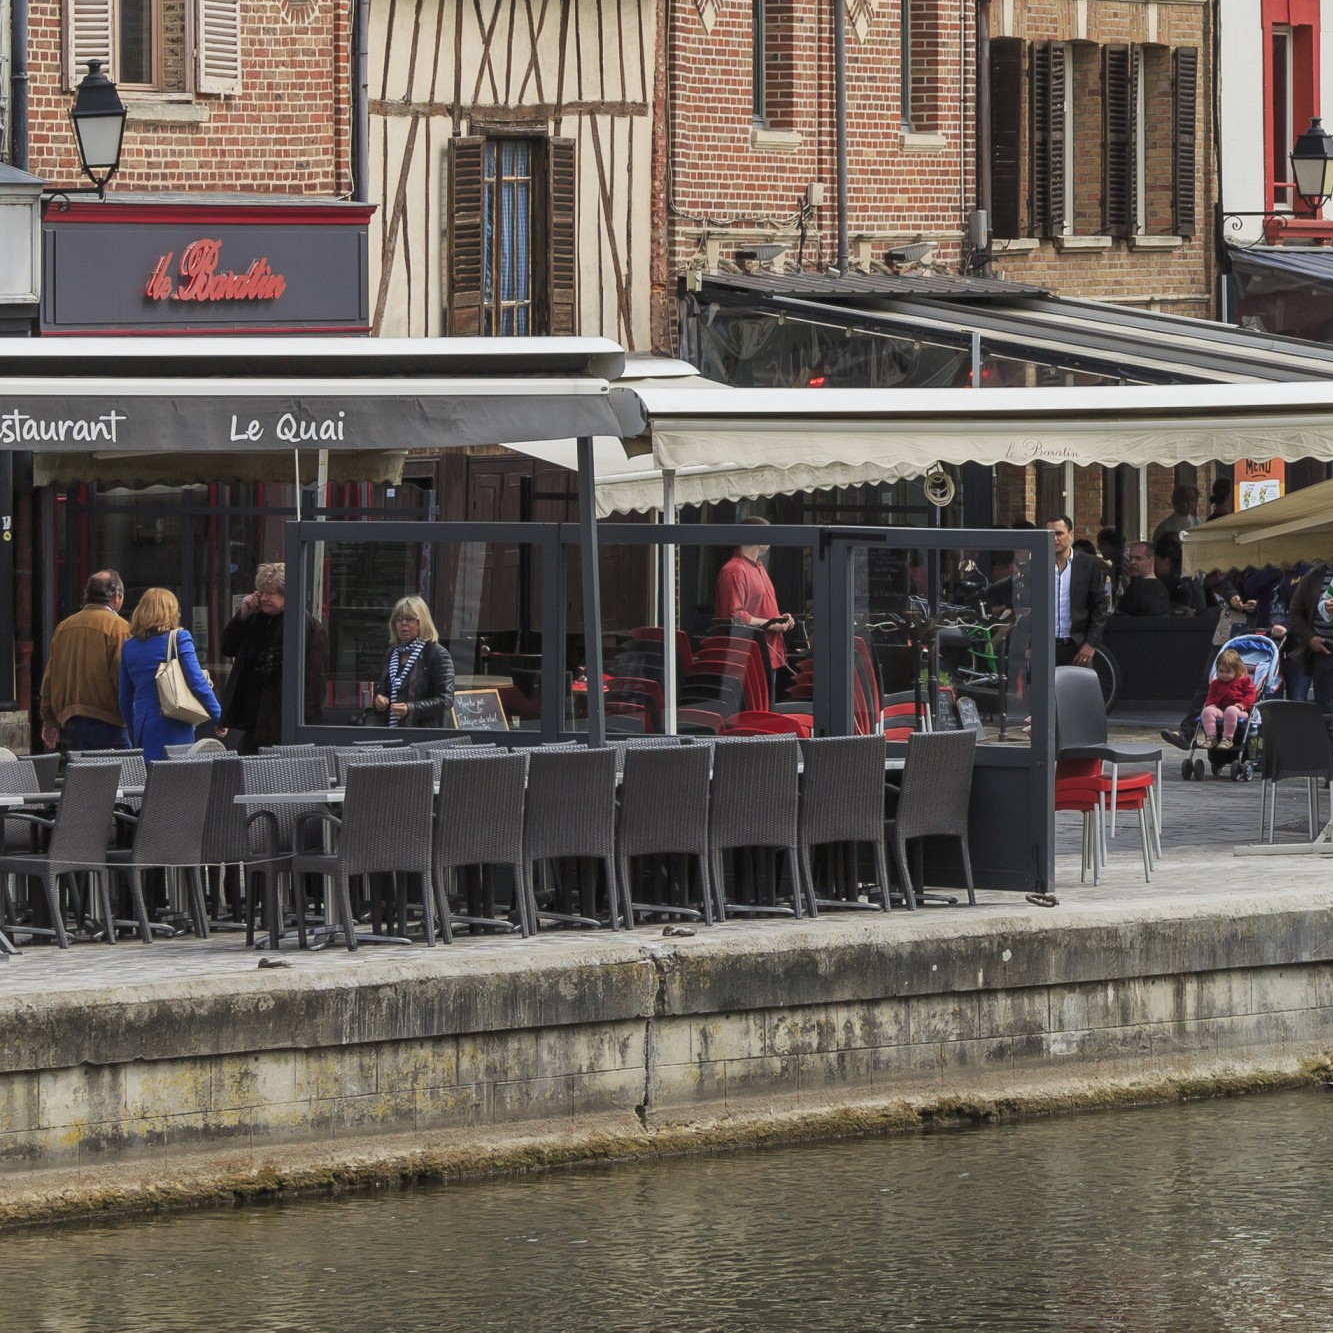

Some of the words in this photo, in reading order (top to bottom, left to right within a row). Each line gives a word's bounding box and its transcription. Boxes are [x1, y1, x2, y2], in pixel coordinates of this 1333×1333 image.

[230, 415, 264, 442] Le
[276, 411, 345, 442] Quai
[1023, 438, 1081, 459] Baratin
